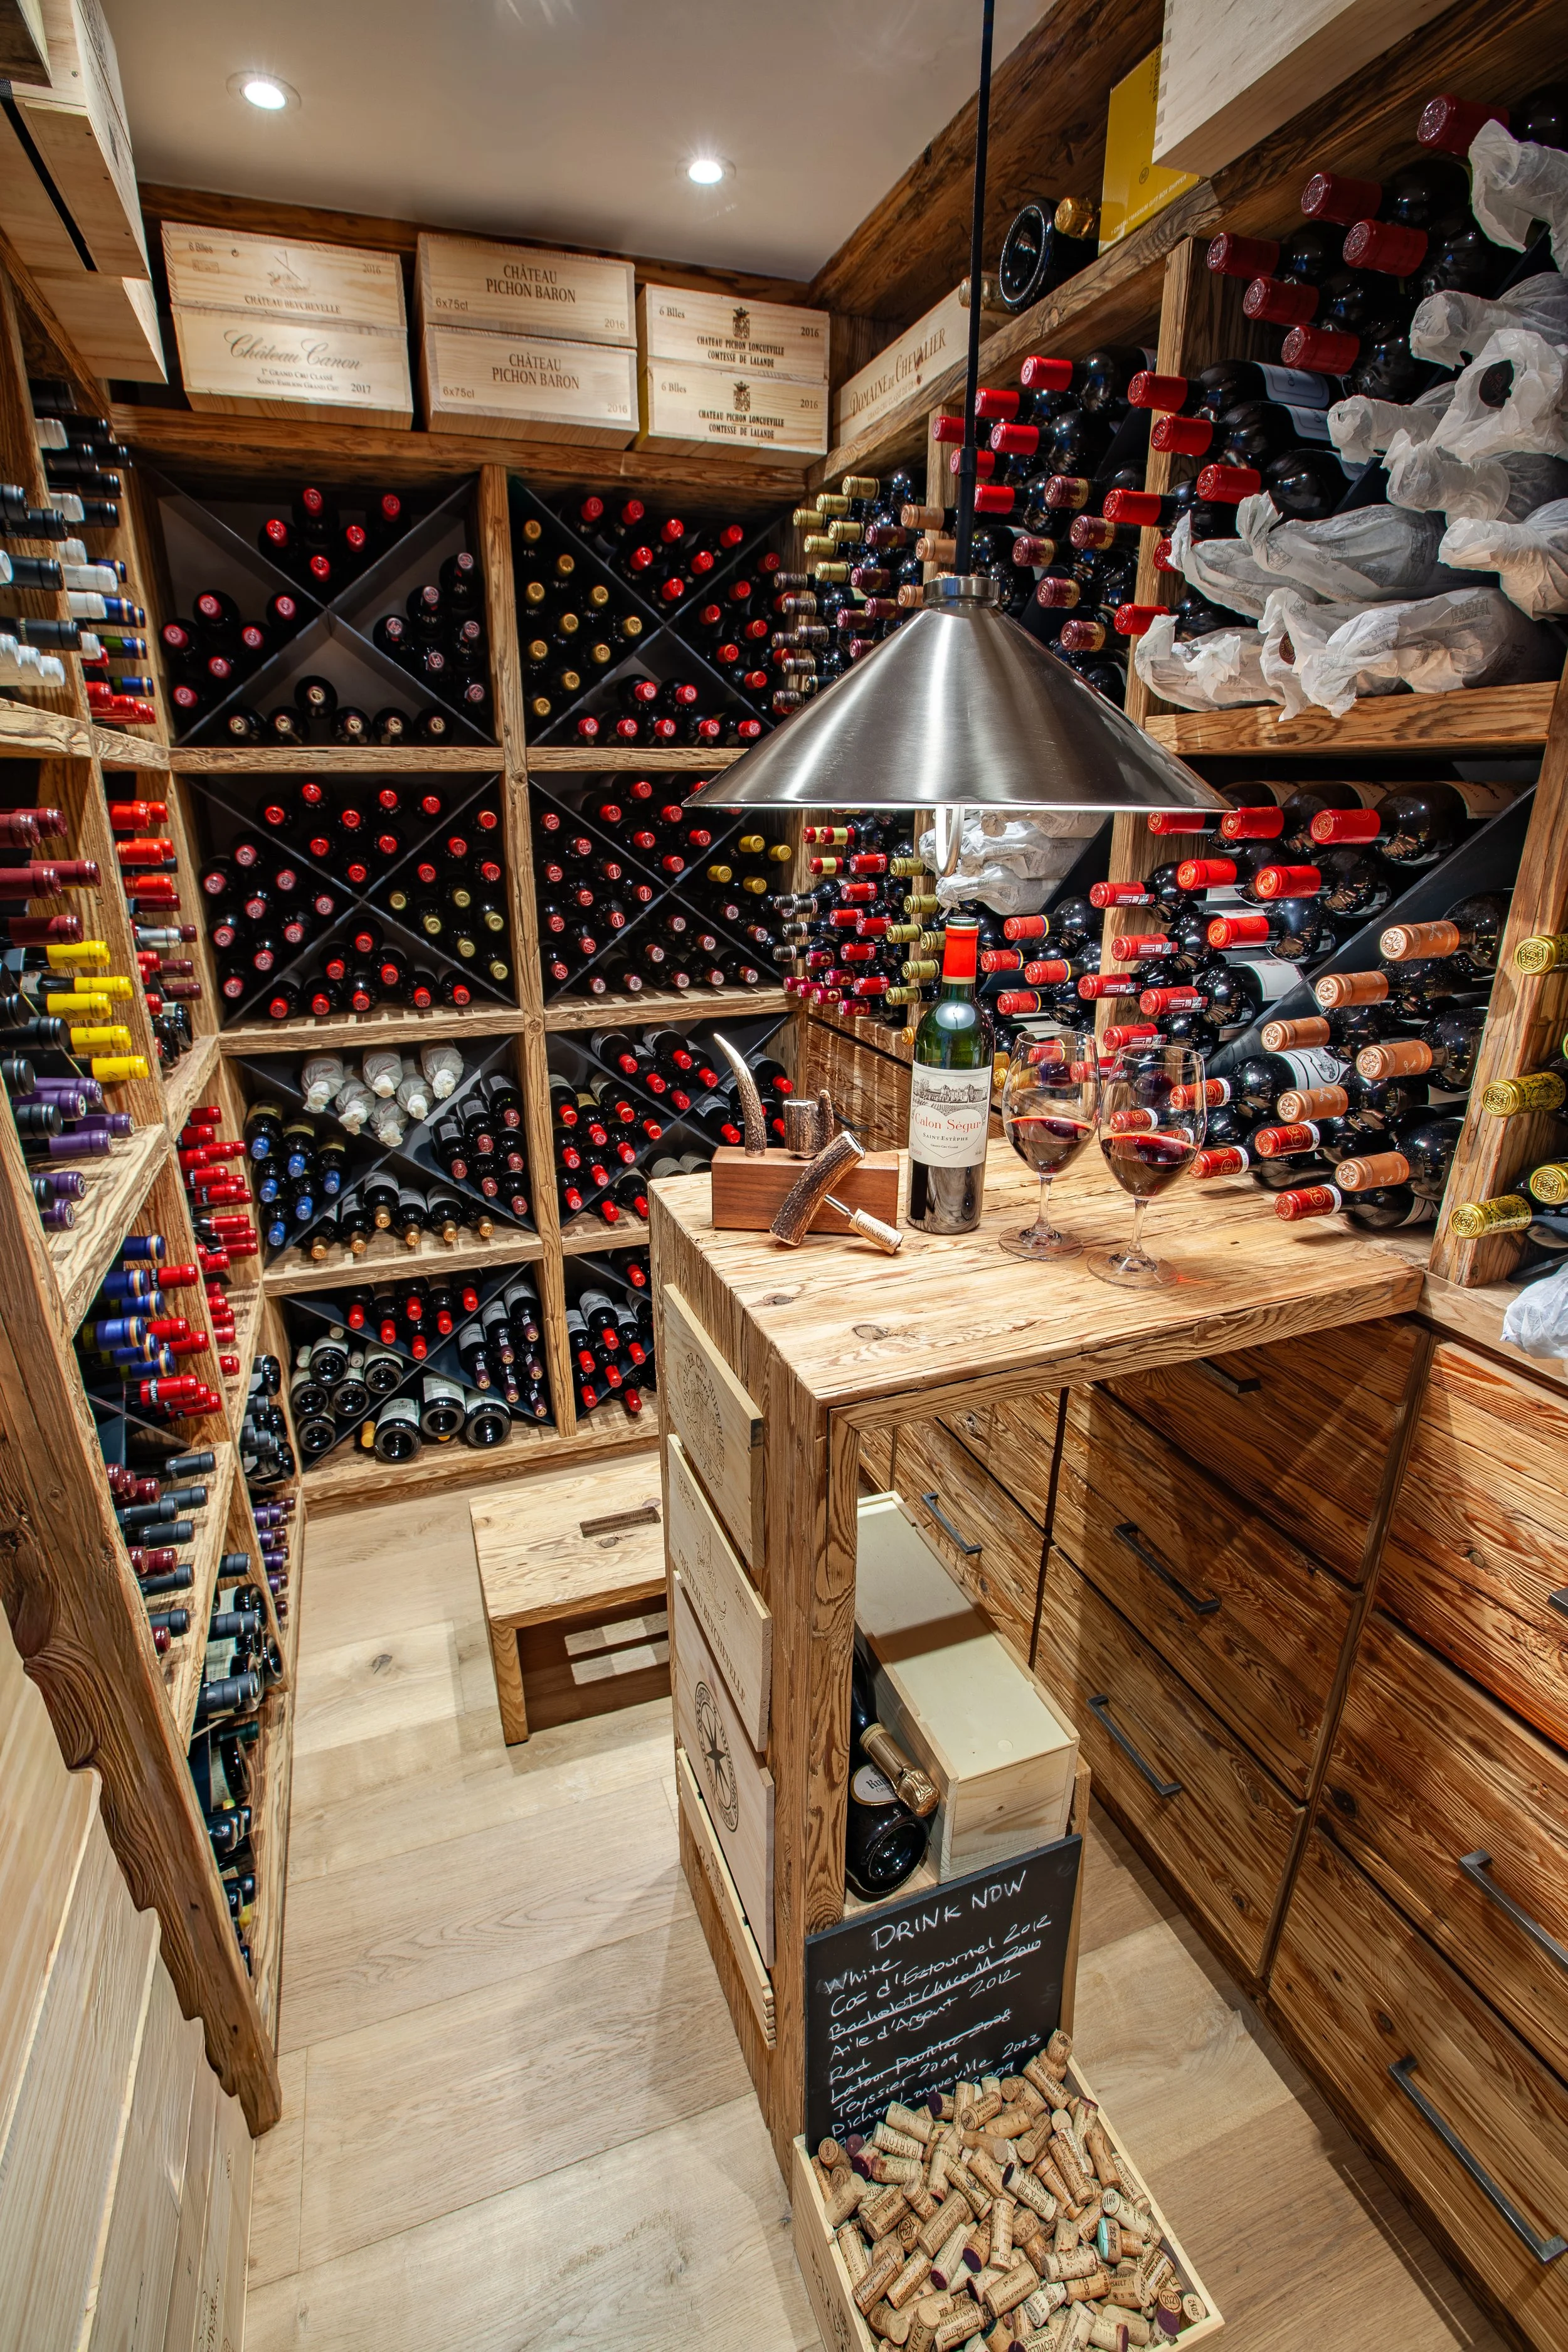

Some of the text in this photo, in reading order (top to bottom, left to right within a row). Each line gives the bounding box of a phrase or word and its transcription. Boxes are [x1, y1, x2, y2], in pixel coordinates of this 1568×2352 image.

[504, 263, 557, 283] CHÂTEAU
[486, 278, 576, 303] PICHON BARON
[436, 297, 468, 311] 6x75cl
[659, 307, 664, 315] 6
[605, 318, 625, 329] 2016
[801, 327, 819, 337] 2016
[224, 330, 362, 370] Château Canon
[697, 336, 723, 347] CHATEAU
[726, 339, 746, 350] PICHON
[509, 352, 561, 371] CHÂTEAU
[707, 350, 775, 368] COMTESSE DE LALANDE
[492, 367, 579, 389] PICHON BARON
[850, 327, 946, 416] DOMAINE DE CHEVALIER
[351, 383, 371, 393] 2017
[443, 386, 475, 399] 6x75cl
[661, 381, 666, 390] 6
[607, 403, 627, 413] 2016
[800, 399, 818, 409] 2016
[699, 410, 723, 421] CHATEAU
[726, 412, 746, 423] PICHON
[709, 423, 775, 439] COMTESSE DE LALANDE
[915, 1112, 981, 1133] Calon Ségur
[923, 1132, 968, 1142] SAINT-ESTÈPHE
[696, 1354, 707, 1379] CRU
[734, 1582, 748, 1618] 2015
[679, 1544, 702, 1611] CHÂTEAU
[704, 1601, 745, 1708] BEYCHEVELLE
[871, 1870, 1027, 1951] DRINK NOW
[830, 1993, 868, 2018] Cos
[1003, 1914, 1052, 1945] 2012
[824, 1959, 903, 1994] White
[828, 2035, 874, 2069] Aile
[969, 1969, 1022, 2000] 2012
[1004, 2035, 1041, 2059] 2003
[829, 2060, 871, 2085] Red
[834, 2052, 959, 2118] Teyssier 2009
[883, 2133, 918, 2156] BARTON
[1115, 2163, 1137, 2196] CHASSAGNE
[953, 2173, 980, 2209] CONTERNO
[882, 2198, 896, 2213] 2011
[896, 2262, 931, 2304] NUITS-ST-GEORGES
[1009, 2272, 1019, 2283] CRU
[1034, 2296, 1044, 2312] 2014
[1163, 2294, 1179, 2305] 2021
